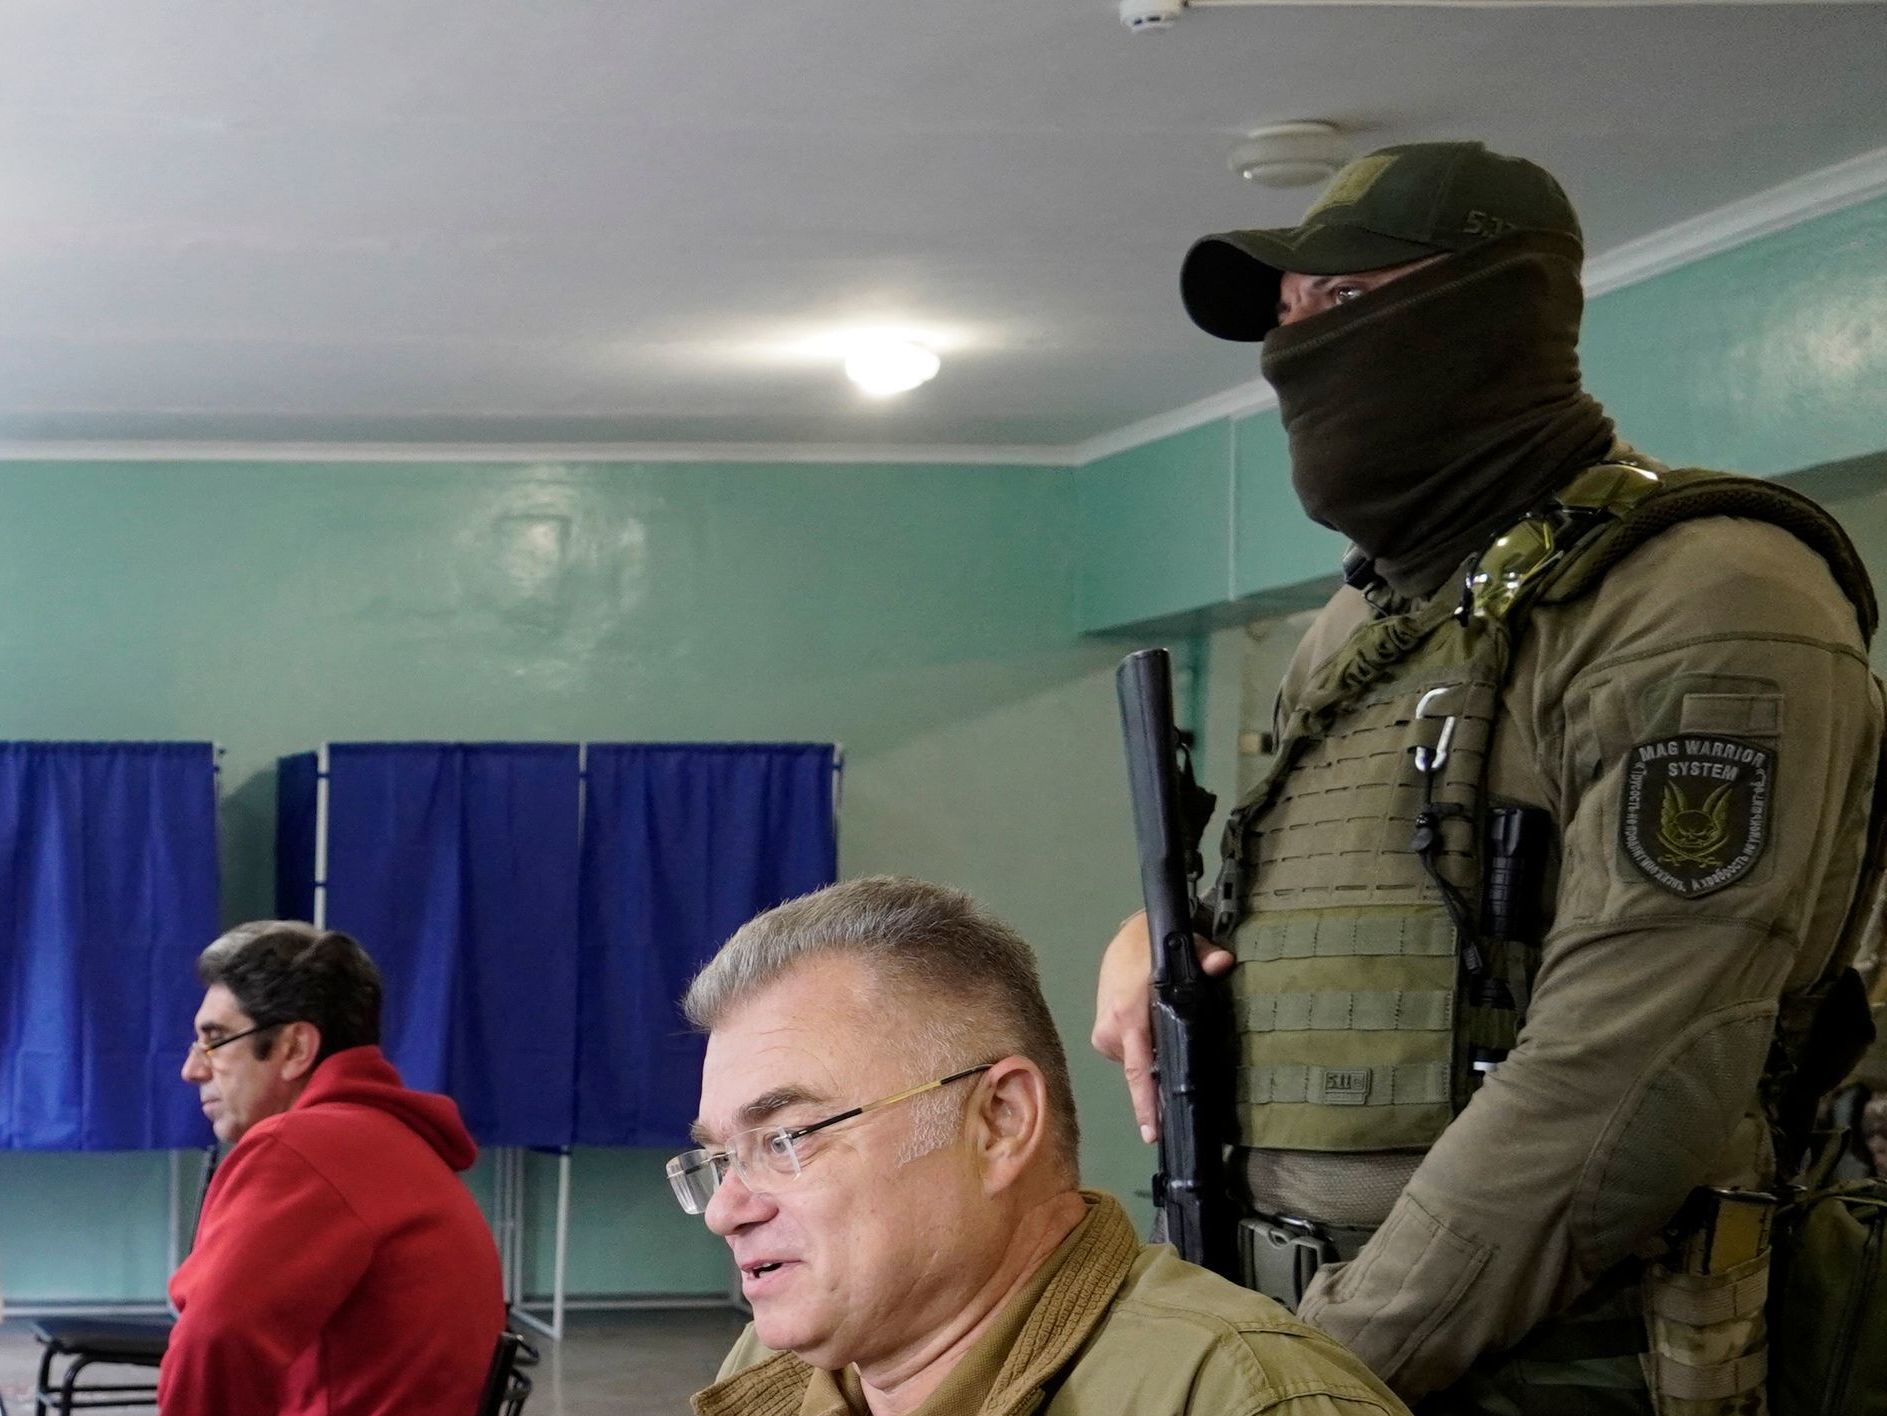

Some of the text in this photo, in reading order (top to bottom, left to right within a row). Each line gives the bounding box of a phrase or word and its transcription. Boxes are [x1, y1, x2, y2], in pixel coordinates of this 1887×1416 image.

[1638, 740, 1766, 768] MAG WARRIOR
[1668, 761, 1739, 781] SYSTEM
